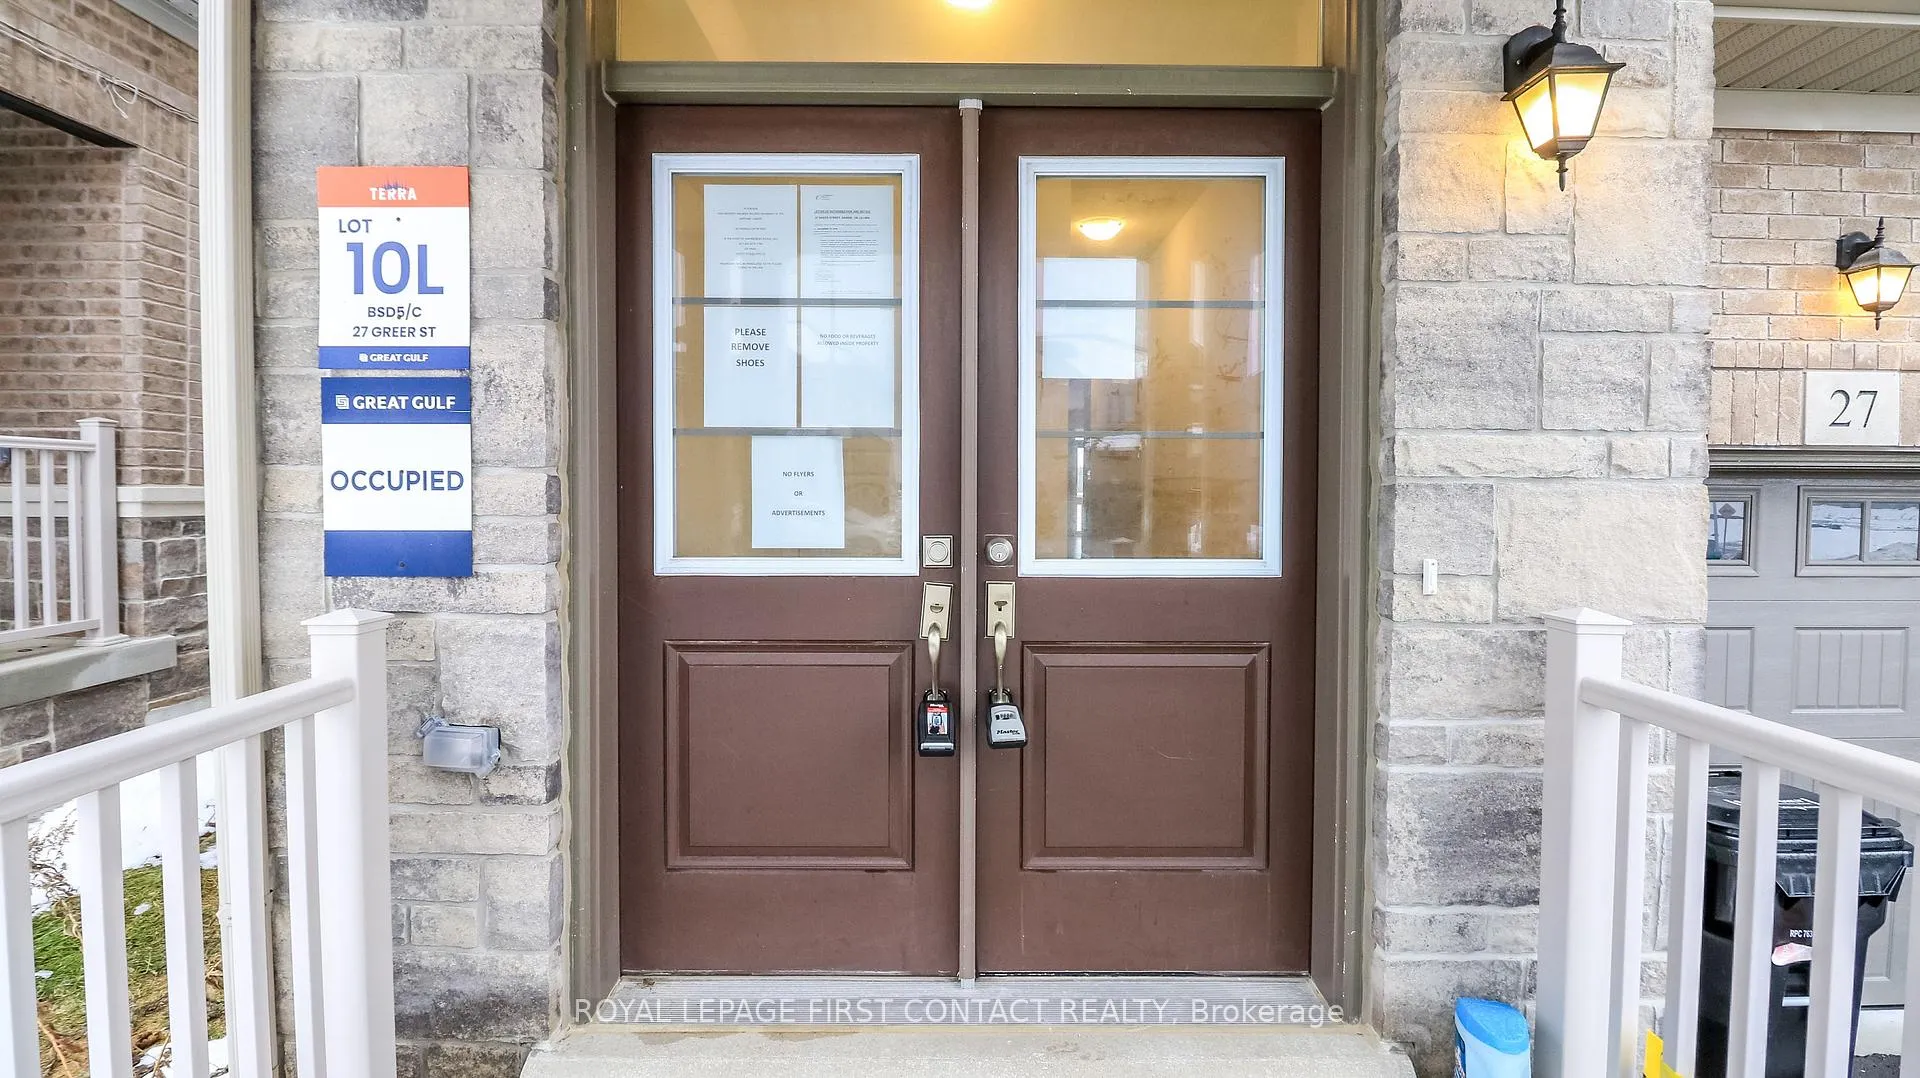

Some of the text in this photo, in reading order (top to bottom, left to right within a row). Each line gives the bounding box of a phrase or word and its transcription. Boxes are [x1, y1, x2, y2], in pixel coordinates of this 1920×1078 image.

[369, 187, 417, 201] TERRA
[338, 218, 373, 233] LOT
[346, 241, 444, 295] 10L
[367, 303, 422, 320] BSD5/C
[352, 326, 437, 338] 27 GREER ST
[734, 328, 767, 336] PLEASE
[731, 342, 770, 351] REMOVE
[369, 353, 429, 363] GREAT GULF
[736, 359, 765, 367] SHOES
[352, 395, 456, 410] GREAT GULF
[1828, 389, 1878, 428] 27
[330, 470, 464, 491] OCCUPIED
[1789, 929, 1803, 938] RPC
